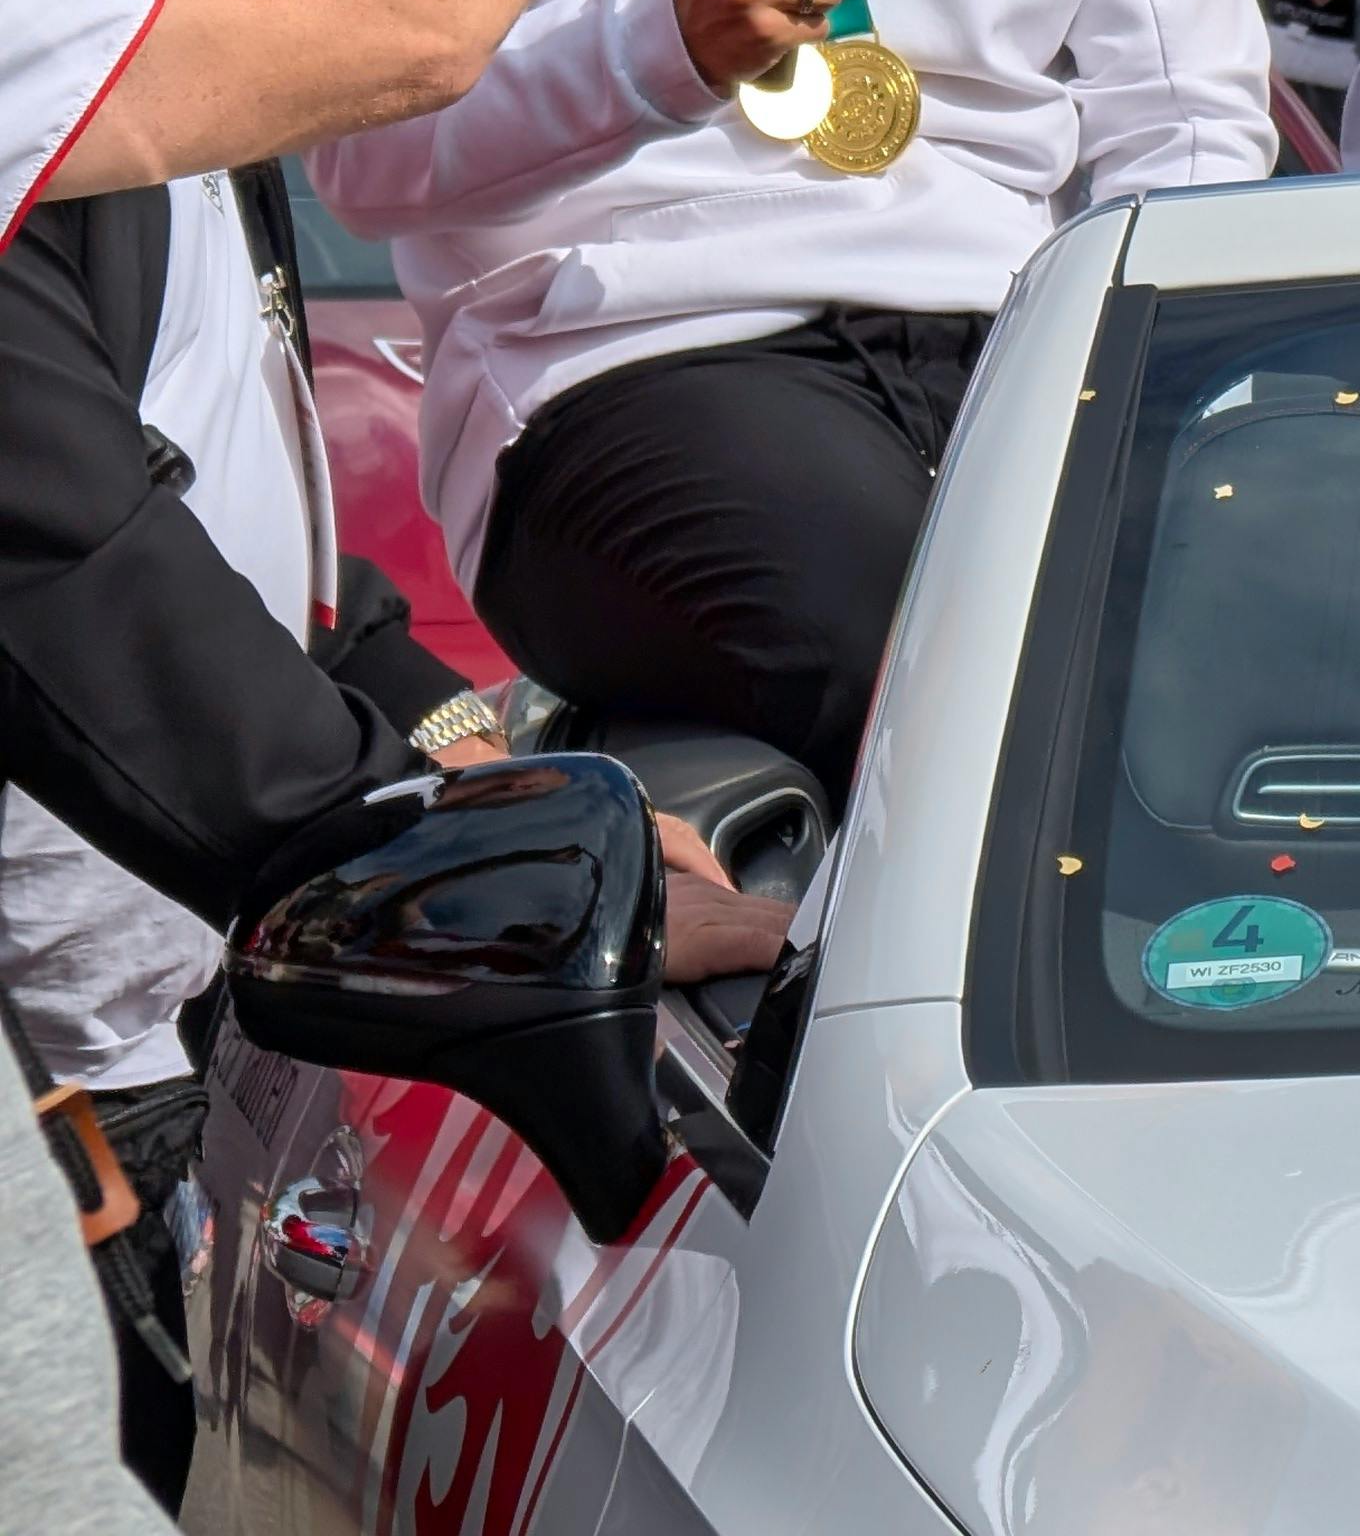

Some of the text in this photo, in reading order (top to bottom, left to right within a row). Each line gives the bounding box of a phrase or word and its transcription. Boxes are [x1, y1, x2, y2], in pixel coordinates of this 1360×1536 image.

[1211, 904, 1265, 954] 4
[1189, 960, 1282, 978] WI ZF2530
